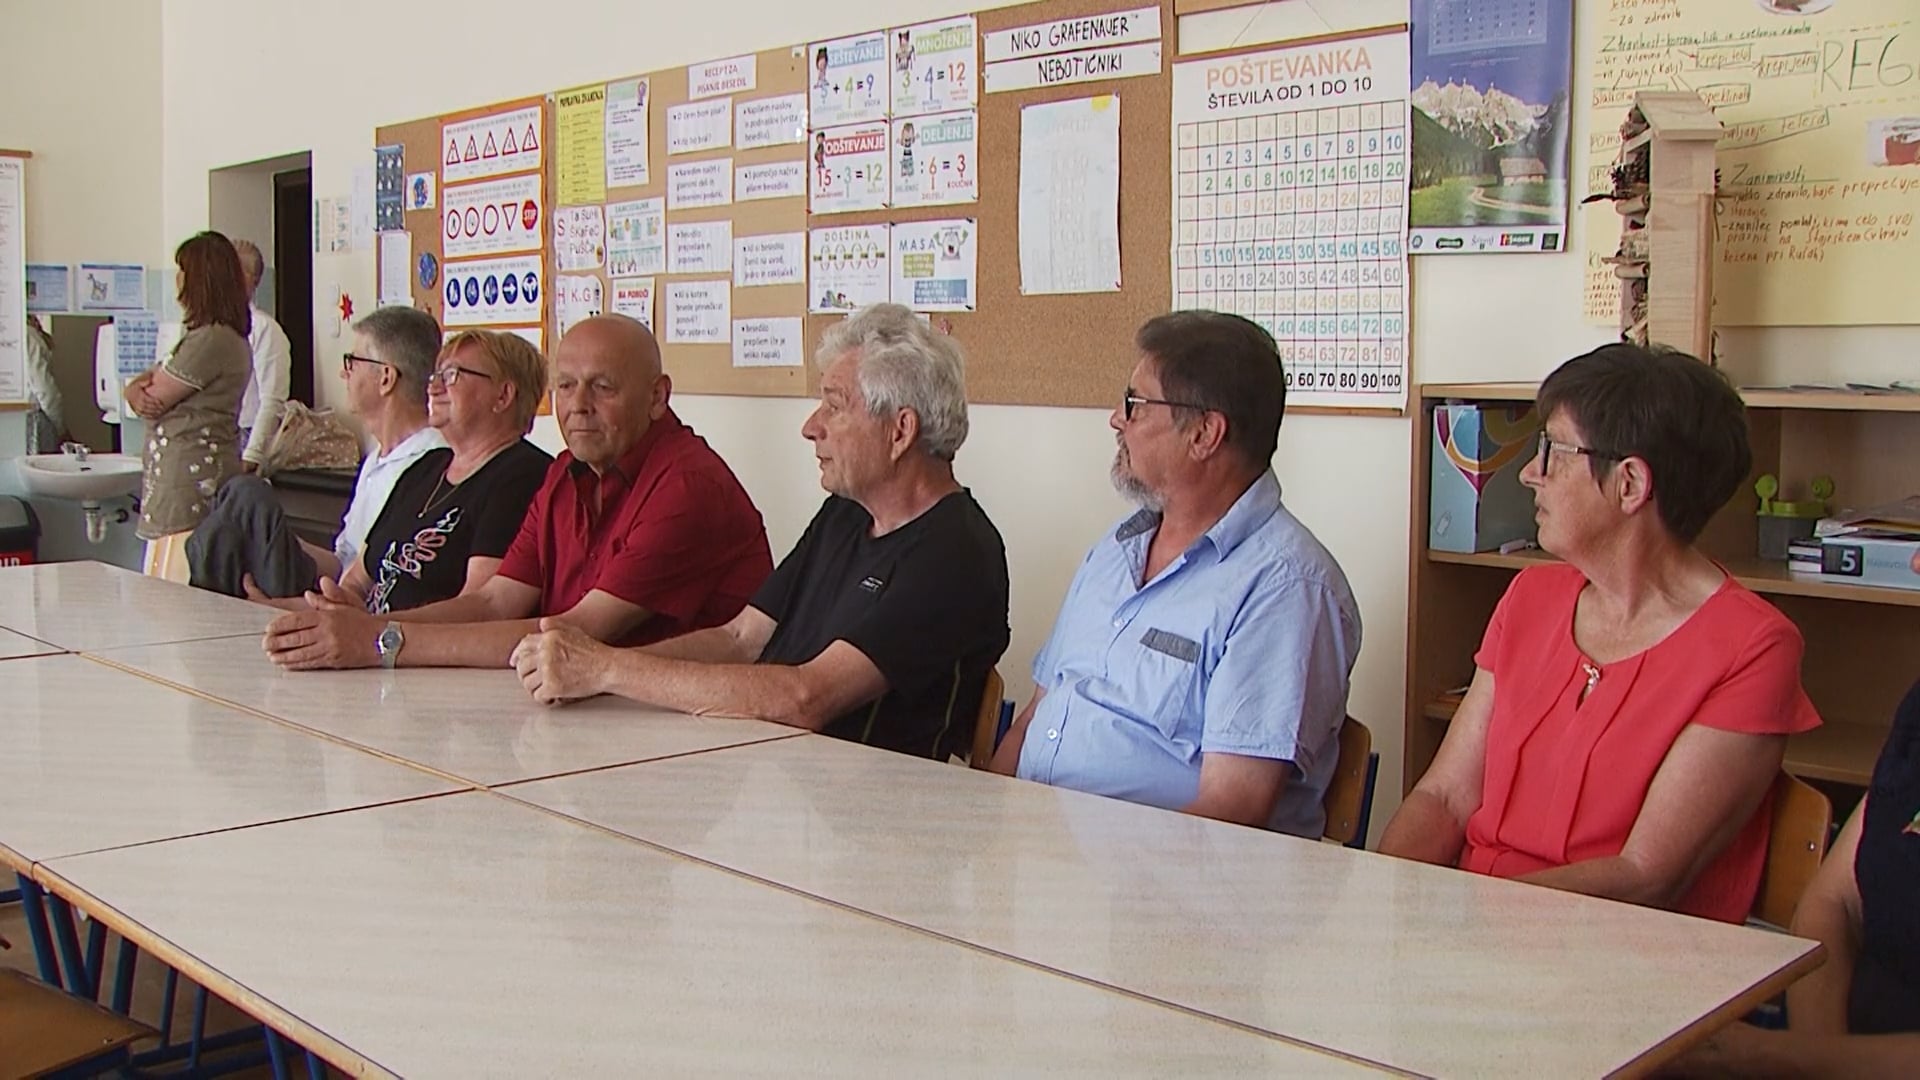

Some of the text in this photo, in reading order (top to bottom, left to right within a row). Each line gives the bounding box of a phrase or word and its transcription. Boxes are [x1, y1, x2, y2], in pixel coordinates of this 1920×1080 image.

[917, 31, 972, 54] MNOŽENJE
[1011, 16, 1129, 53] NIKO GRAFENAUER
[828, 43, 884, 66] SEŠTEVANJE
[1821, 34, 1920, 93] REG
[925, 66, 933, 84] 4
[949, 62, 965, 82] 12
[1038, 53, 1122, 84] NEBOTIČNIKI
[1207, 47, 1372, 90] POŠTEVANKA
[845, 76, 853, 94] 4
[866, 73, 874, 91] 9
[1208, 77, 1372, 109] ŠTEVILA OD 1 DO 10
[923, 123, 972, 142] DELJENJE
[826, 135, 885, 154] ODŠTEVANJE
[1207, 135, 1402, 166] 1 2 3 4 5 6 7 8 9 10
[817, 168, 832, 187] 15
[866, 163, 882, 182] 12
[929, 156, 937, 175] 6
[957, 154, 966, 172] 3
[1206, 161, 1402, 191] 2 4 6 8 10 12 14 16 18 20
[1206, 187, 1401, 213] 3 6 9 12 15 18 21 24 27 30
[524, 209, 537, 220] STOP
[824, 229, 870, 242] DOLŽINA
[899, 238, 936, 251] MASA
[1205, 237, 1400, 262] 5 10 15 20 25 30 35 40 45 50
[1205, 267, 1400, 288] 6 12 18 24 30 36 42 48 54 60
[1278, 319, 1400, 335] 40 48 56 64 72 80
[1299, 347, 1313, 361] 54
[1320, 347, 1335, 361] 63
[1341, 347, 1356, 361] 72
[1362, 348, 1376, 361] 81
[1384, 346, 1400, 361] 90
[1299, 373, 1314, 386] 60
[1320, 373, 1335, 387] 70
[1340, 373, 1356, 388] 80
[1361, 373, 1377, 388] 90
[1382, 374, 1400, 387] 100
[1840, 550, 1856, 571] 5
